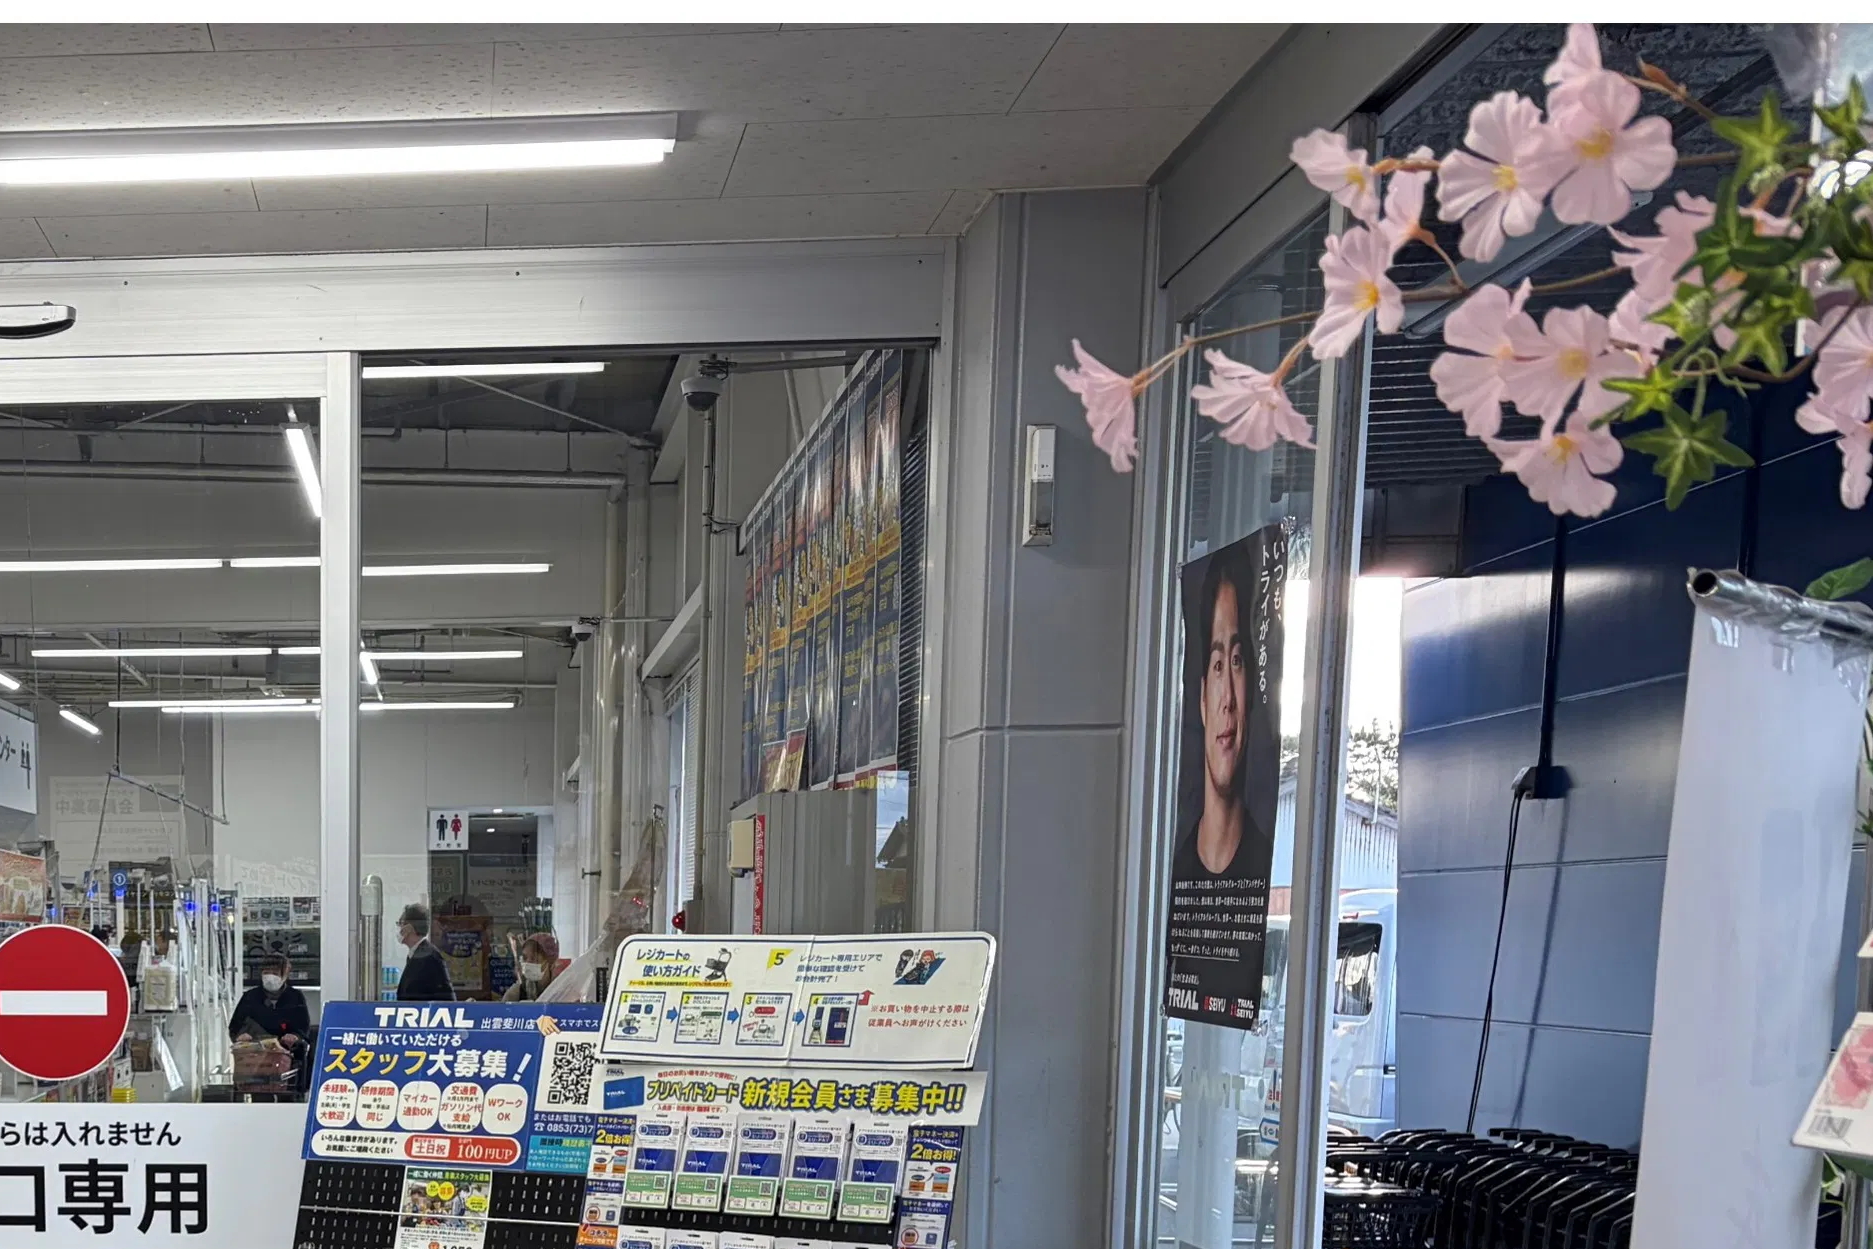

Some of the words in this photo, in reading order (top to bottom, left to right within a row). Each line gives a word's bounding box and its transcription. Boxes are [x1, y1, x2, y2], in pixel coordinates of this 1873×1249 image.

[1273, 540, 1285, 621] いつも、
[1258, 544, 1271, 704] トライがある。
[636, 948, 691, 961] レジカートの
[773, 952, 785, 966] 5
[800, 953, 883, 963] レジカート専用エリアで
[642, 964, 701, 978] 使い方ガイド
[796, 963, 866, 973] 簡単な確認を受けて
[1168, 988, 1199, 1011] TRIAL
[1209, 996, 1227, 1013] SEIYU
[870, 1004, 970, 1014] ※お買い物を中止する際は
[1236, 1009, 1254, 1019] SEIYU
[374, 1007, 474, 1028] TRIAL
[868, 1018, 968, 1028] 従業員へお声がけください
[480, 1017, 536, 1030] 出雲斐川店
[331, 1031, 462, 1048] 一緒に働いていただける
[324, 1047, 532, 1083] スタッフ大募集!
[360, 1087, 396, 1097] 研修期間
[450, 1085, 478, 1095] 交通費
[403, 1093, 438, 1103] マイカー
[647, 1079, 740, 1104] プリペイドカード
[742, 1077, 966, 1116] 新規会員さま募集中!!
[441, 1102, 484, 1113] ガソリン代
[488, 1098, 524, 1107] Wワーク
[366, 1112, 384, 1122] 同じ
[402, 1106, 434, 1117] 通勤OK
[497, 1112, 511, 1121] OK
[452, 1113, 471, 1123] 支給
[533, 1113, 592, 1124] またはお電話でも
[546, 1123, 593, 1135] 0853(73)7
[321, 1134, 398, 1145] いろんな働き方があります。
[325, 1143, 394, 1154] お気軽にご相談ください
[416, 1143, 446, 1156] 土日祝
[457, 1143, 513, 1161] 100円UP
[910, 1144, 957, 1161] 2倍お得!
